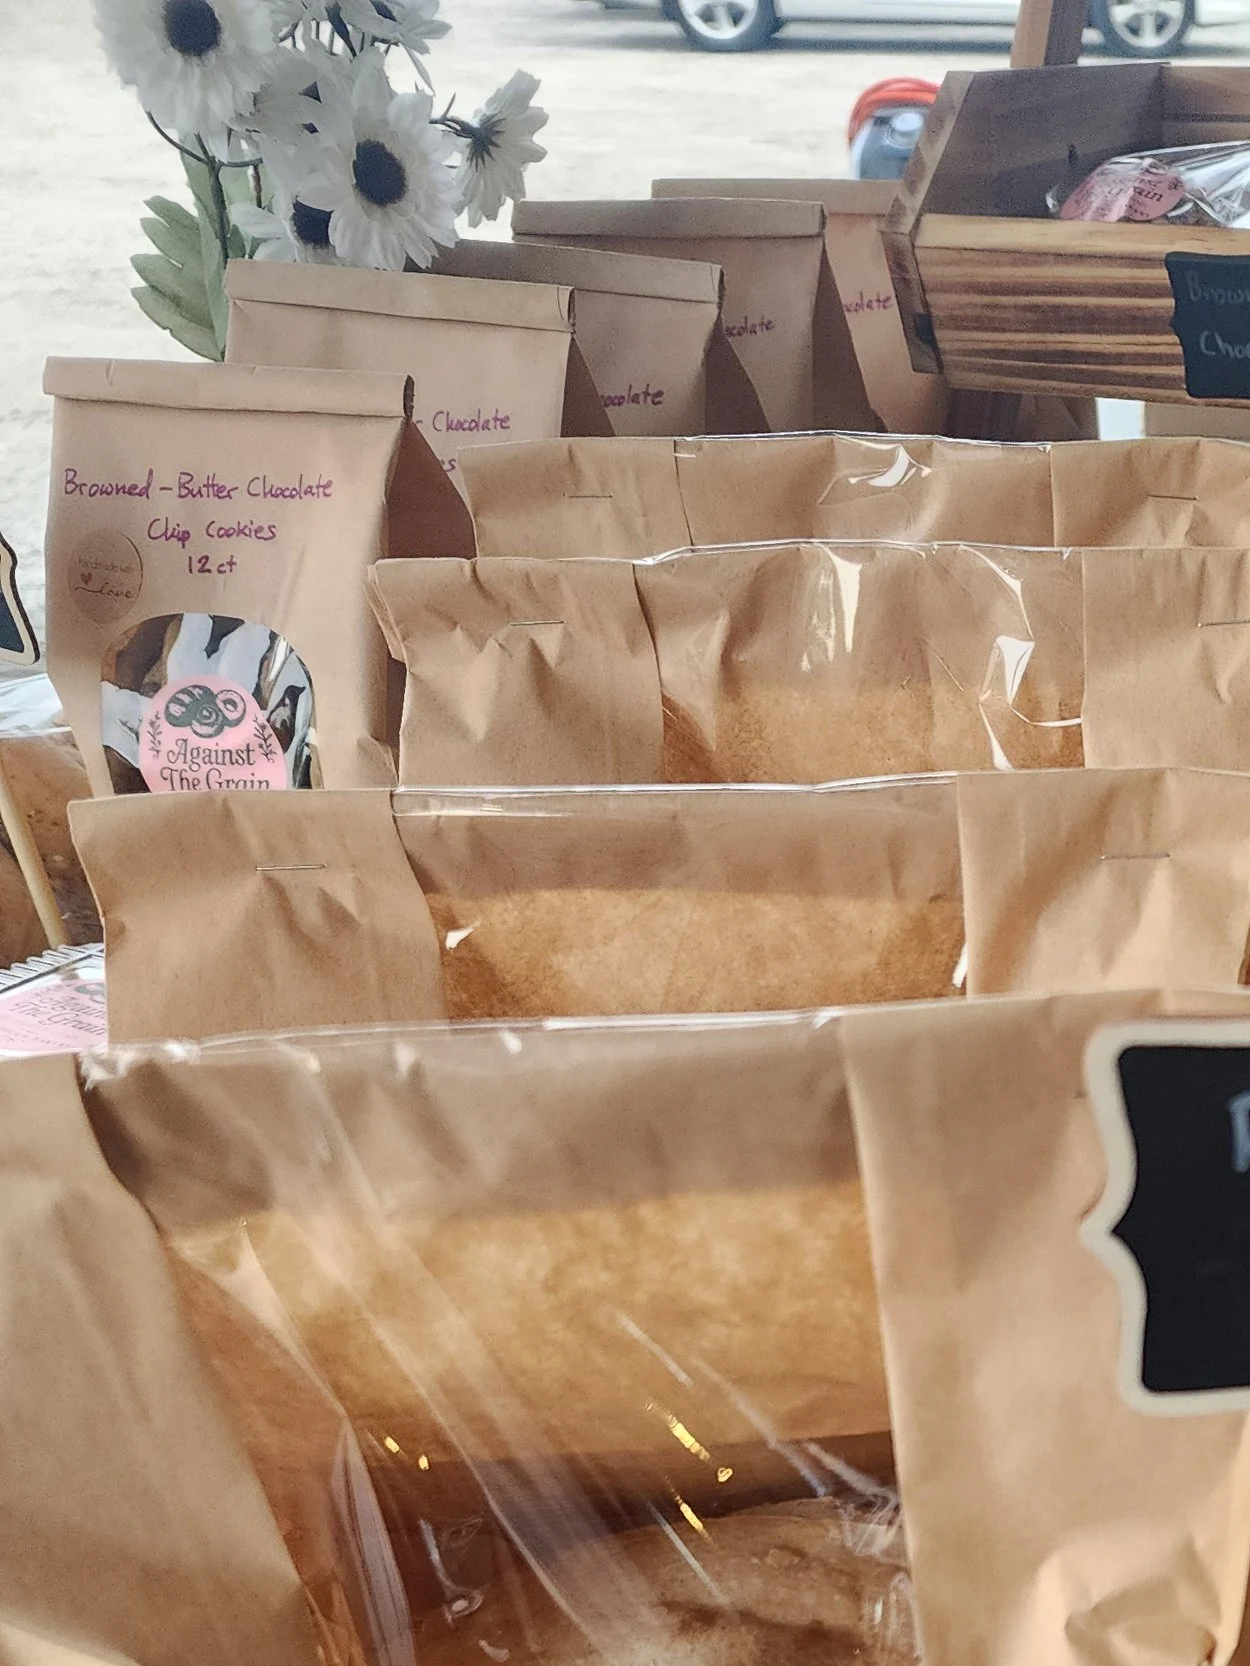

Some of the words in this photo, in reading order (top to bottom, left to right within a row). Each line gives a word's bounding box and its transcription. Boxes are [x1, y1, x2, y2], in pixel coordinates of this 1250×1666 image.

[432, 409, 511, 432] Chocolate
[246, 473, 333, 500] Chocolate
[147, 517, 191, 549] Chip
[205, 519, 277, 541] Cookies
[166, 738, 256, 772] Against
[160, 766, 201, 791] The
